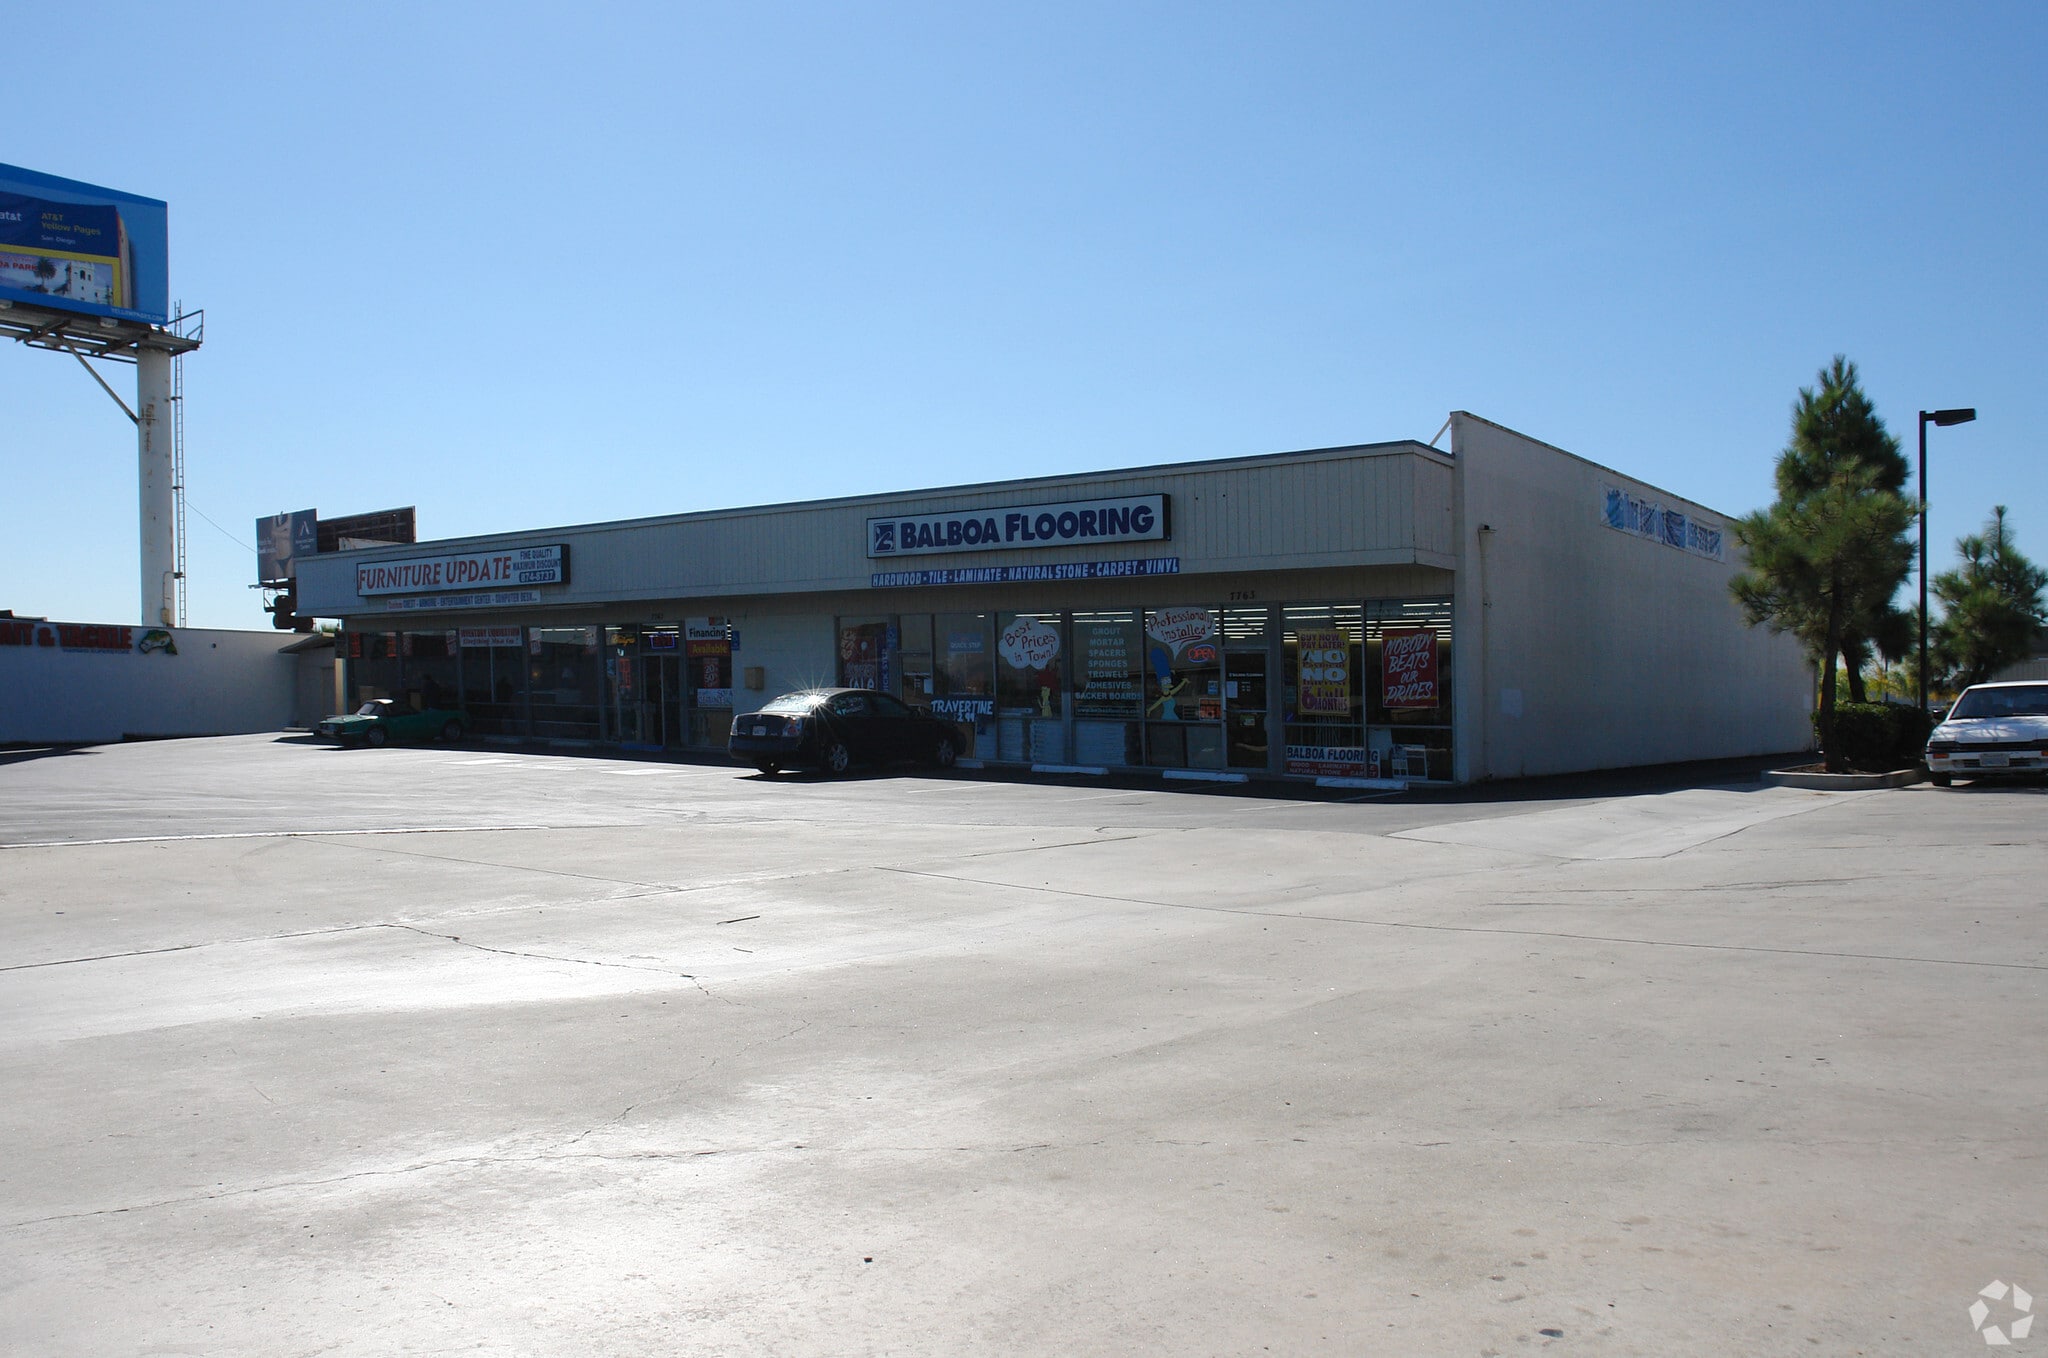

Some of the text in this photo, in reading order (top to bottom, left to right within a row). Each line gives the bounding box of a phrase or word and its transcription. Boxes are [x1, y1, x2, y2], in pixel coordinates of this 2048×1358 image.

[41, 213, 63, 221] AT&T
[41, 221, 101, 236] Yellow Pages
[901, 505, 1154, 549] BALBOA FLOORING
[537, 558, 561, 569] DISCOUNT
[358, 556, 512, 590] FURNITURE UPDATE
[873, 557, 1179, 586] HARDWOOD TILE LAMINATE NATURAL STONE CARPET VINYL
[1229, 590, 1256, 601] 7763
[1148, 611, 1214, 632] Professionally
[58, 625, 133, 649] TACKLE
[689, 628, 726, 639] Financing
[1005, 621, 1031, 647] Best
[1092, 627, 1120, 635] GROUT
[692, 643, 728, 654] Available
[1021, 634, 1056, 649] Prices
[1302, 640, 1345, 649] PAY LATER!
[1385, 632, 1434, 656] NOBODY
[1014, 644, 1055, 662] in Town!
[1088, 649, 1127, 657] SPACERS
[1187, 648, 1217, 660] OPEN
[1301, 649, 1347, 664] NO
[1087, 660, 1128, 668] SPONGES
[1388, 651, 1430, 673] BEATS
[1301, 668, 1348, 682] NO
[1401, 671, 1418, 684] OUR
[1074, 692, 1143, 700] BACKER BOARDS
[1385, 681, 1434, 703] PRICES
[931, 699, 994, 715] TRAVERTINE
[1315, 698, 1348, 711] MONTHS
[1287, 747, 1325, 760] BALBOA
[1328, 750, 1378, 762] FLOORIG
